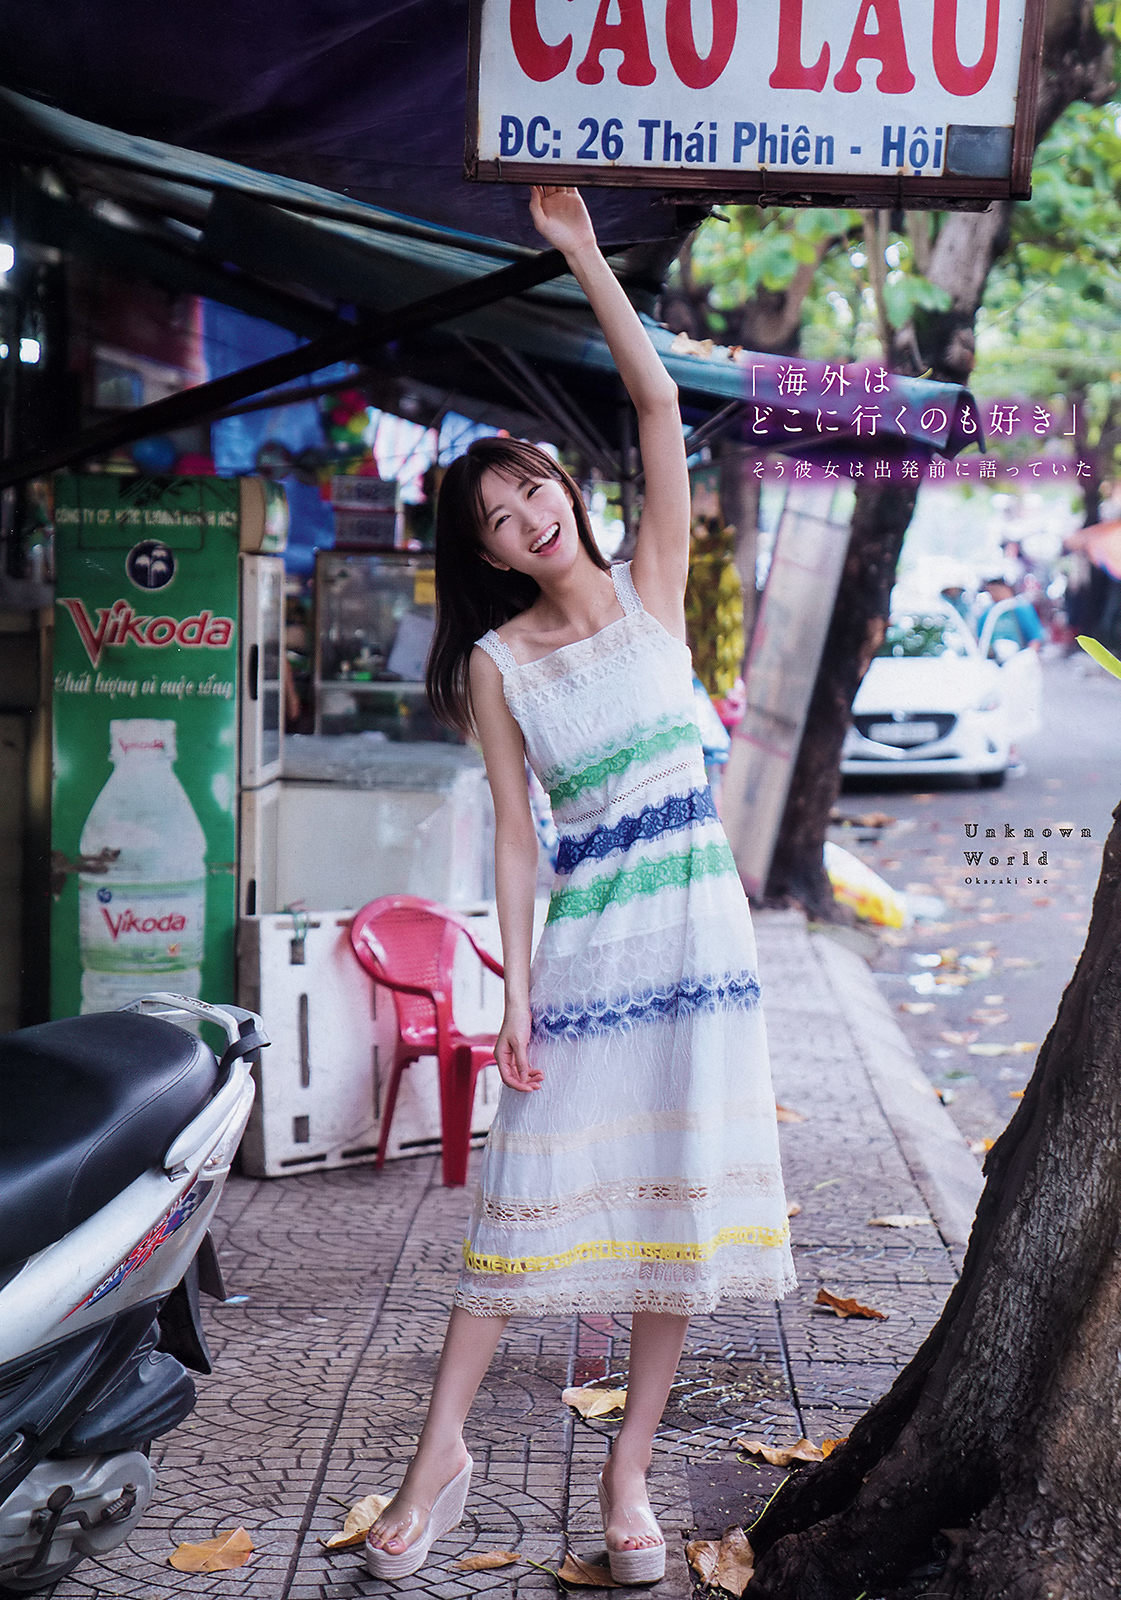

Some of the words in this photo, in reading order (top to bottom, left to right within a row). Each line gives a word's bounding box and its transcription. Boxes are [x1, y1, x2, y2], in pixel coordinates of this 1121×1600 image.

[499, 115, 561, 159] ĐC:
[577, 117, 624, 161] 26
[638, 119, 717, 163] Thái
[733, 122, 834, 165] Phiên
[881, 126, 943, 176] Hội
[56, 597, 235, 669] Vikoda
[101, 907, 186, 942] Vikoda
